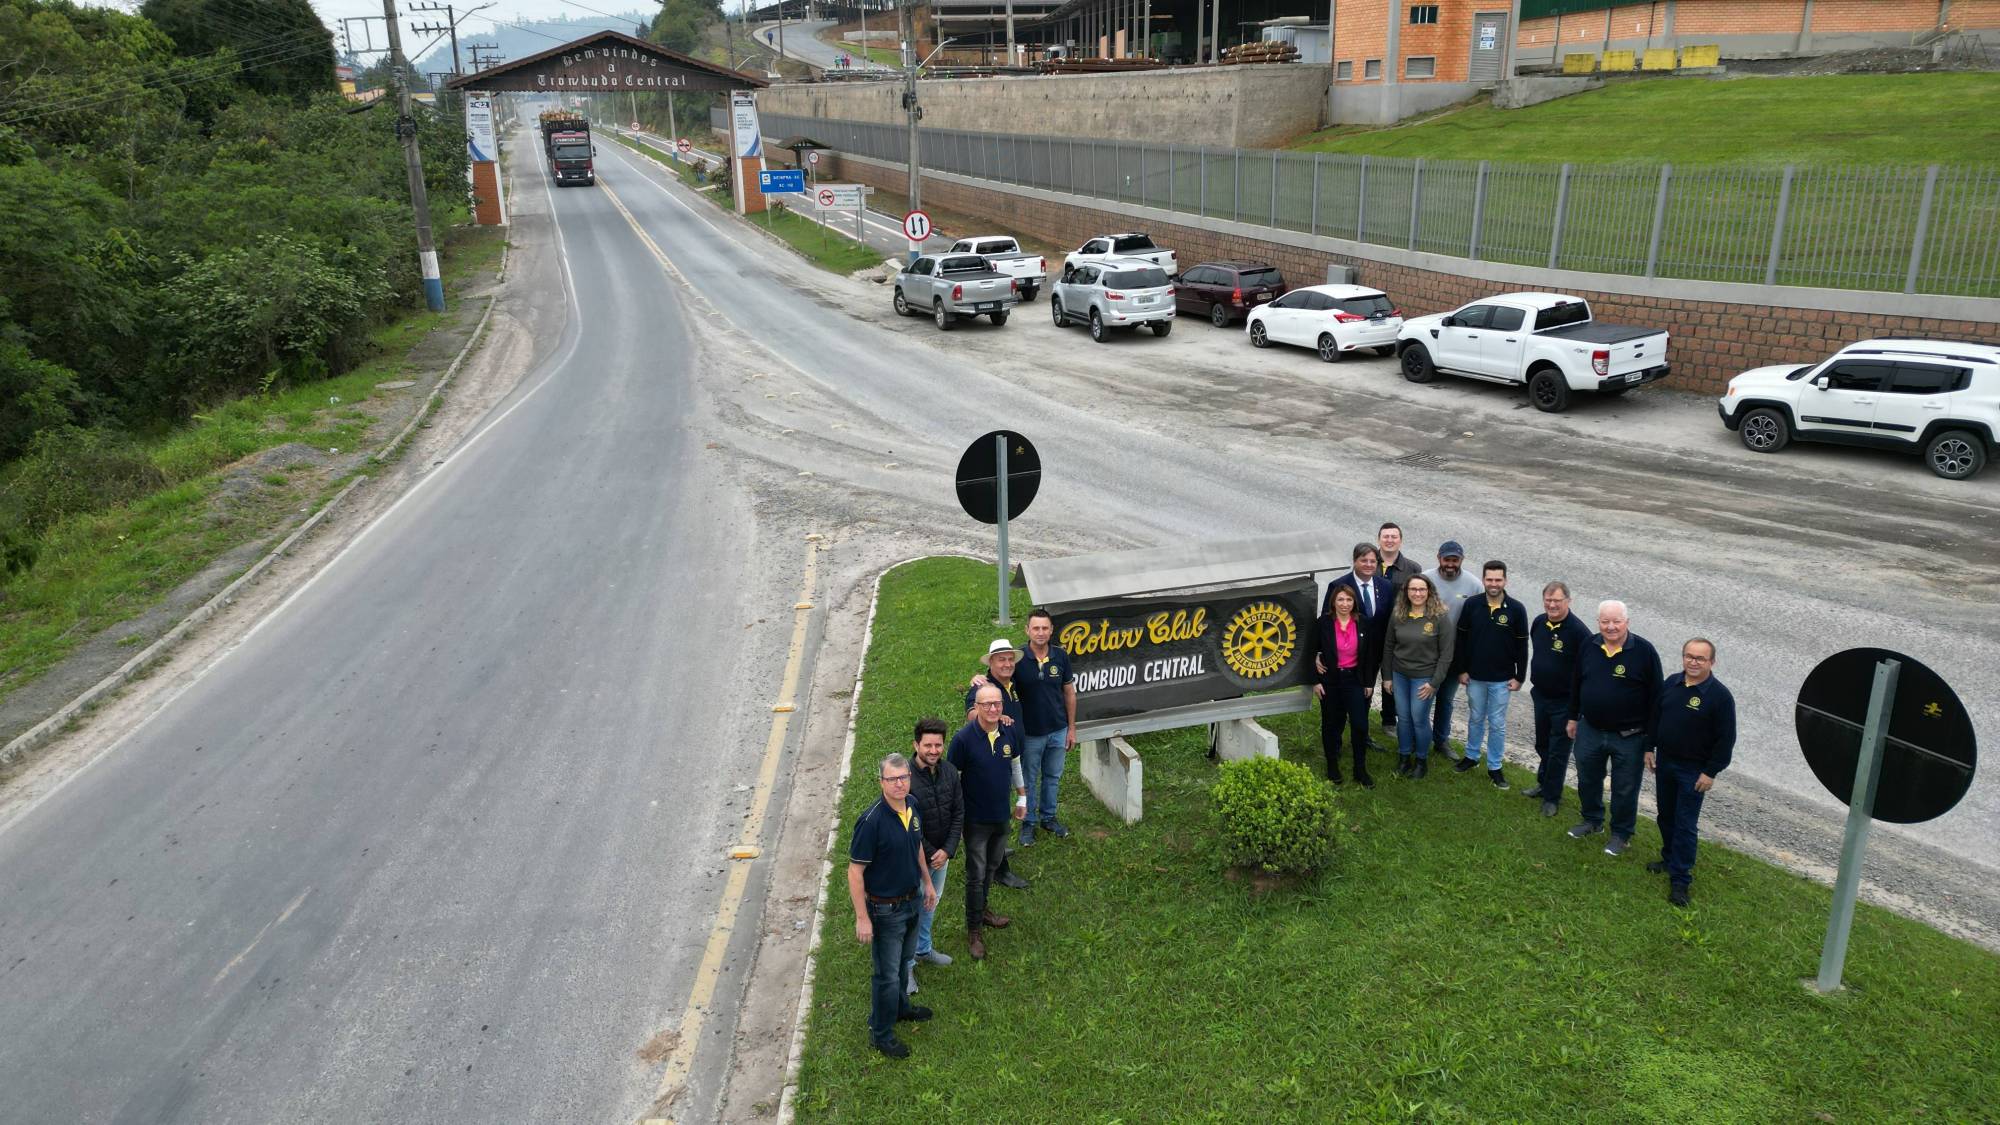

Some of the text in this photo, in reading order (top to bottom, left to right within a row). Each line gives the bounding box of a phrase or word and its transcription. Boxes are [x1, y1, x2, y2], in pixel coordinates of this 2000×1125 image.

[562, 46, 657, 67] Bem-vindos
[608, 63, 616, 73] a
[537, 74, 686, 87] Trombudo Central
[1246, 612, 1277, 625] ROTARY
[1059, 607, 1208, 656] Rotary Club
[1234, 648, 1285, 670] INTERNATIONAL
[1072, 654, 1206, 694] ROMBUDO CENTRAL
